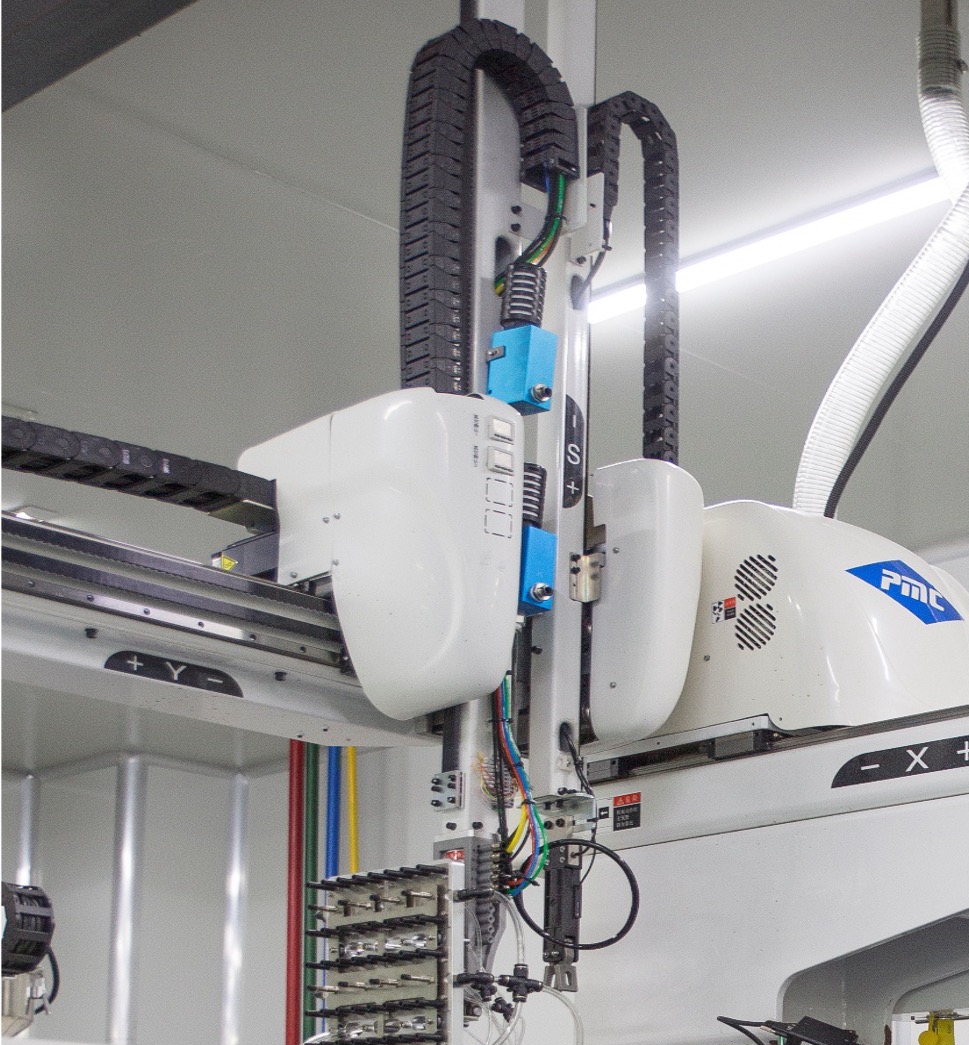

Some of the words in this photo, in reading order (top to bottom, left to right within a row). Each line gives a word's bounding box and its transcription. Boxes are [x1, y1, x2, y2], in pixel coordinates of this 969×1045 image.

[567, 443, 581, 465] S
[880, 568, 945, 612] PMC
[165, 661, 187, 681] Y
[905, 746, 930, 772] X
